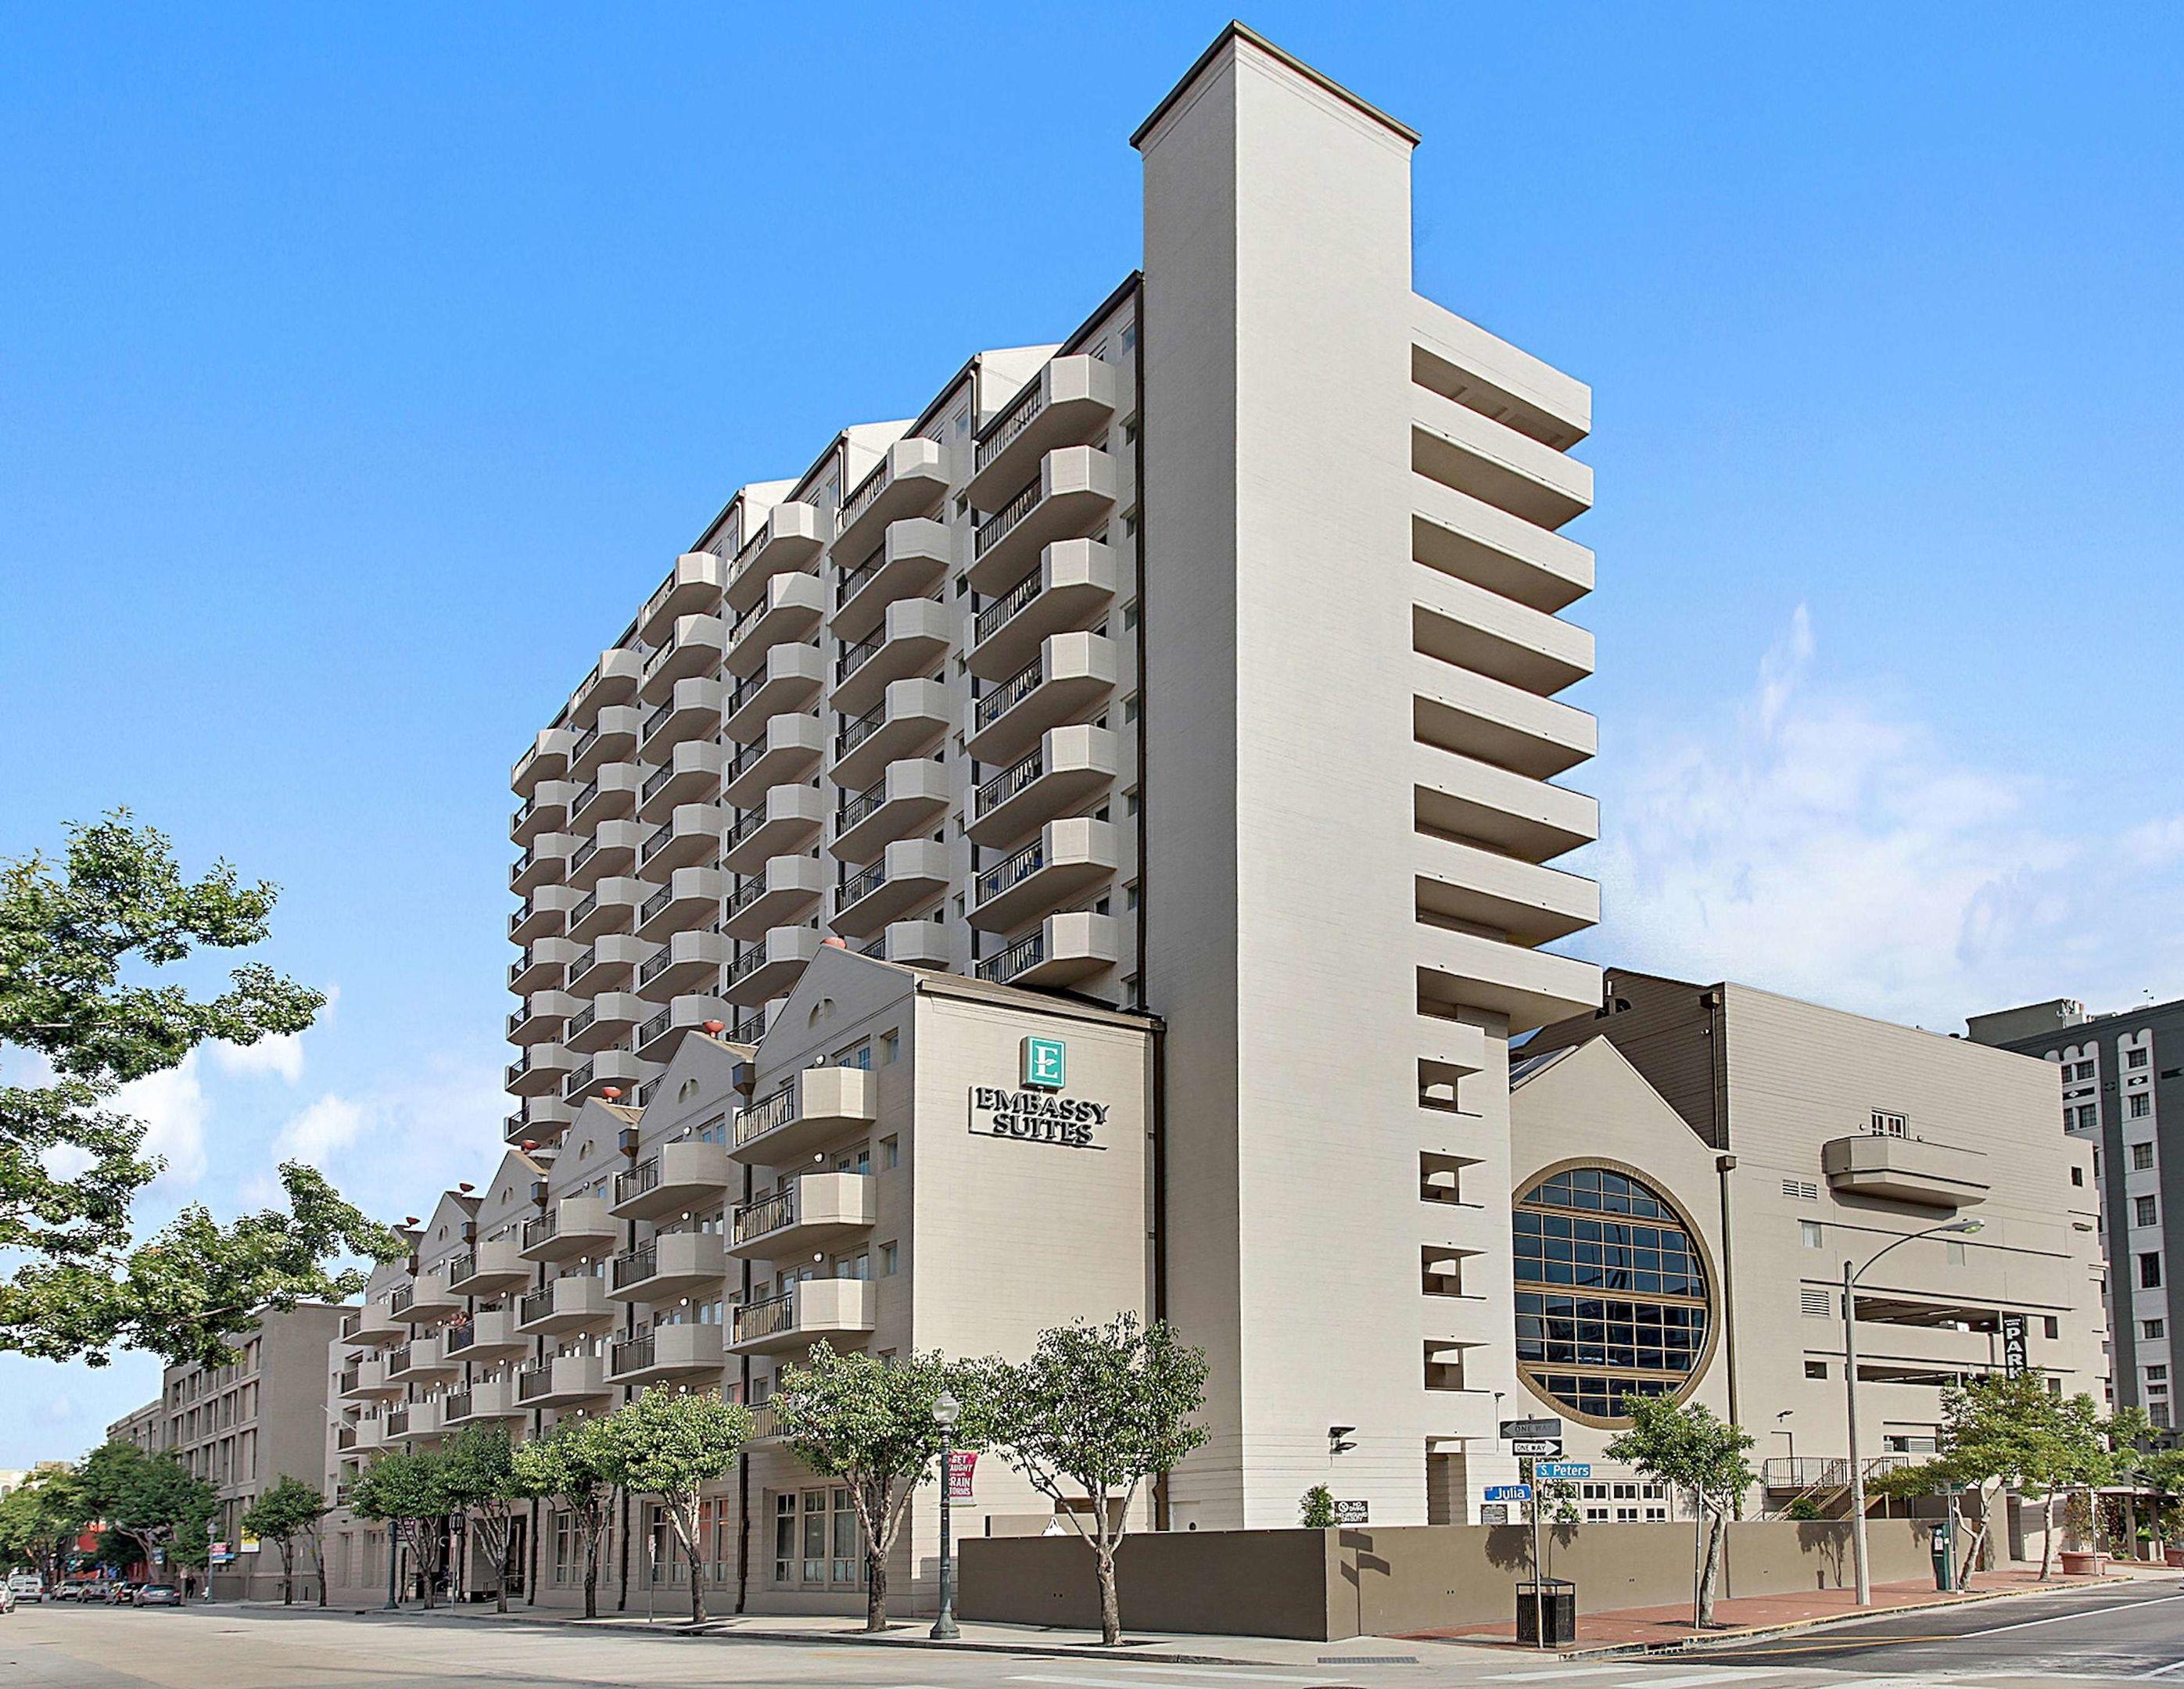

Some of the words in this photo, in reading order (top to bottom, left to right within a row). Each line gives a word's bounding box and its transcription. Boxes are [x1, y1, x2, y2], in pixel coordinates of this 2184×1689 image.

[1034, 1045, 1058, 1079] E
[976, 1087, 1110, 1124] EMBASSY
[993, 1113, 1093, 1143] SUITES
[1540, 1465, 1549, 1476] S.
[1553, 1465, 1590, 1476] Peters
[949, 1486, 971, 1495] TORMS
[1494, 1486, 1526, 1500] Julia
